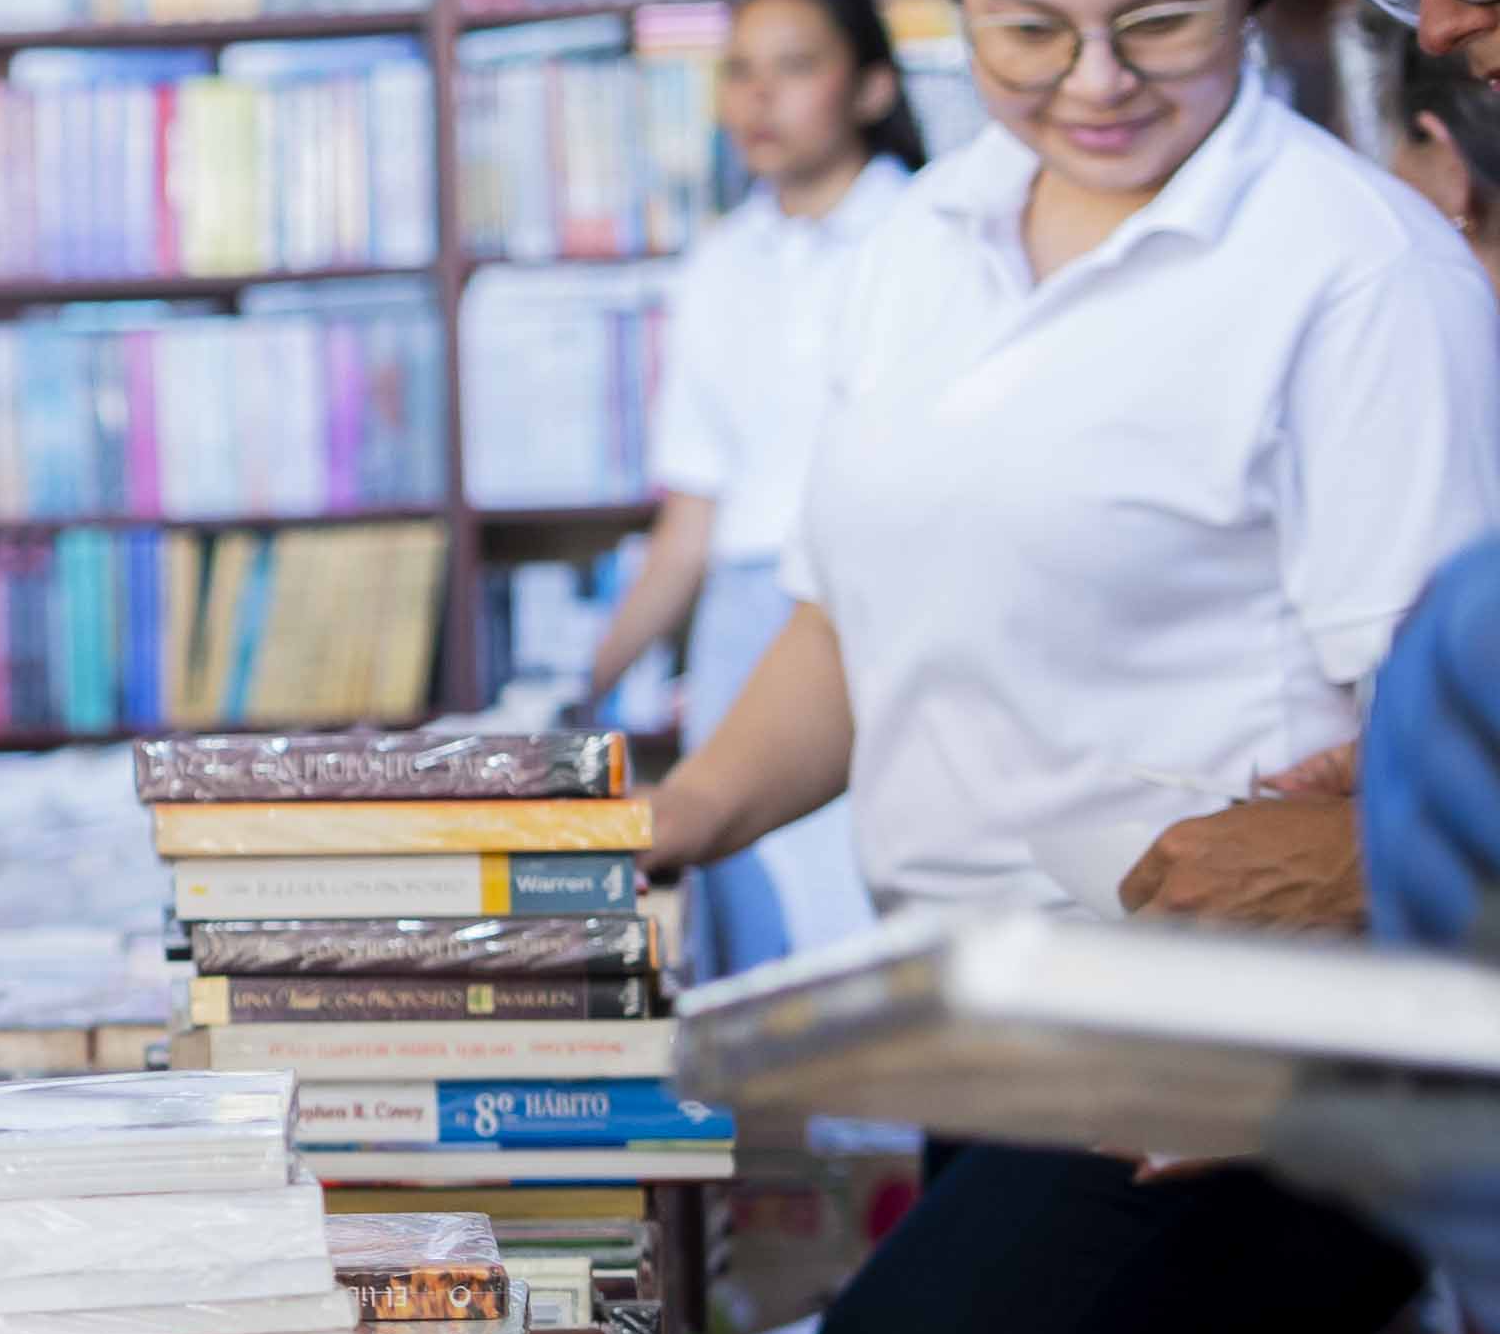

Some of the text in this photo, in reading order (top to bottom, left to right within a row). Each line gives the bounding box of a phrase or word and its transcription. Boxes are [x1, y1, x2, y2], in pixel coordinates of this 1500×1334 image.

[516, 873, 594, 895] Warren
[297, 1102, 348, 1124] ephen
[526, 1091, 609, 1118] HÁBITO
